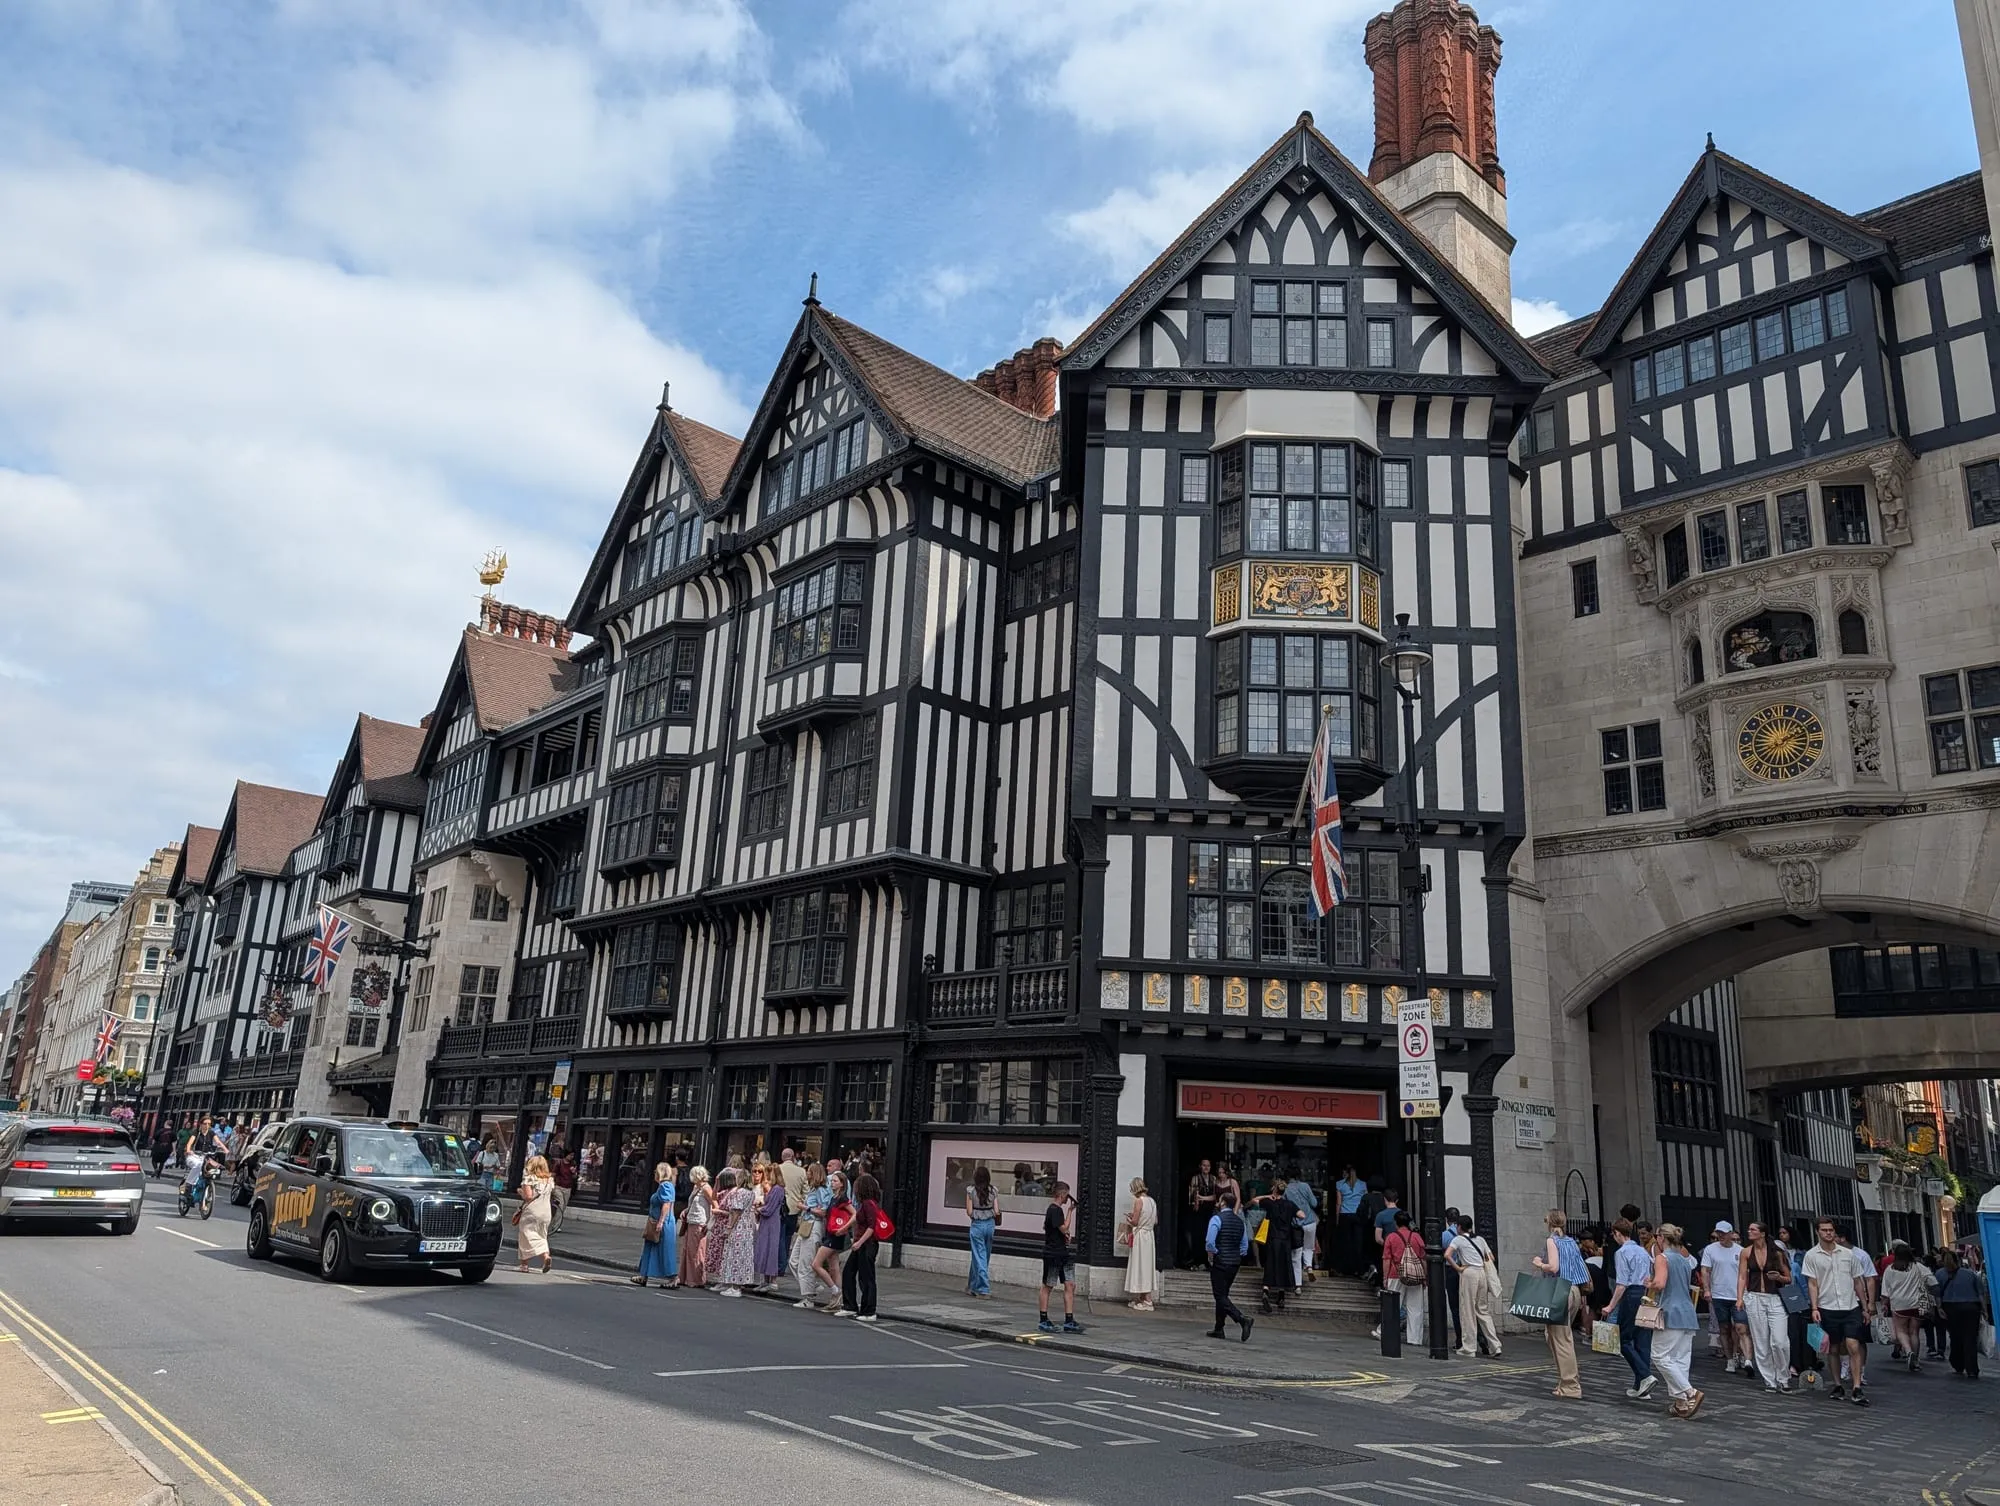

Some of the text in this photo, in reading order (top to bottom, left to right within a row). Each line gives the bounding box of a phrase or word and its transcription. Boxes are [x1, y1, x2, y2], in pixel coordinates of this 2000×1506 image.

[1147, 977, 1403, 1017] LIBERTY
[1399, 1002, 1430, 1012] PEDESTRIAN
[1403, 1010, 1426, 1021] ZONE
[1403, 1065, 1421, 1073] Except
[1407, 1072, 1428, 1080] loading
[1186, 1089, 1212, 1106] UP
[1219, 1092, 1246, 1108] TO
[1256, 1094, 1294, 1111] 70%
[1302, 1096, 1341, 1113] OFF
[1501, 1100, 1525, 1113] KINGLY
[1525, 1103, 1547, 1117] STREET
[271, 1183, 316, 1236] jump
[425, 1241, 465, 1251] LF23 FPZ
[1509, 1304, 1550, 1319] ANTLER
